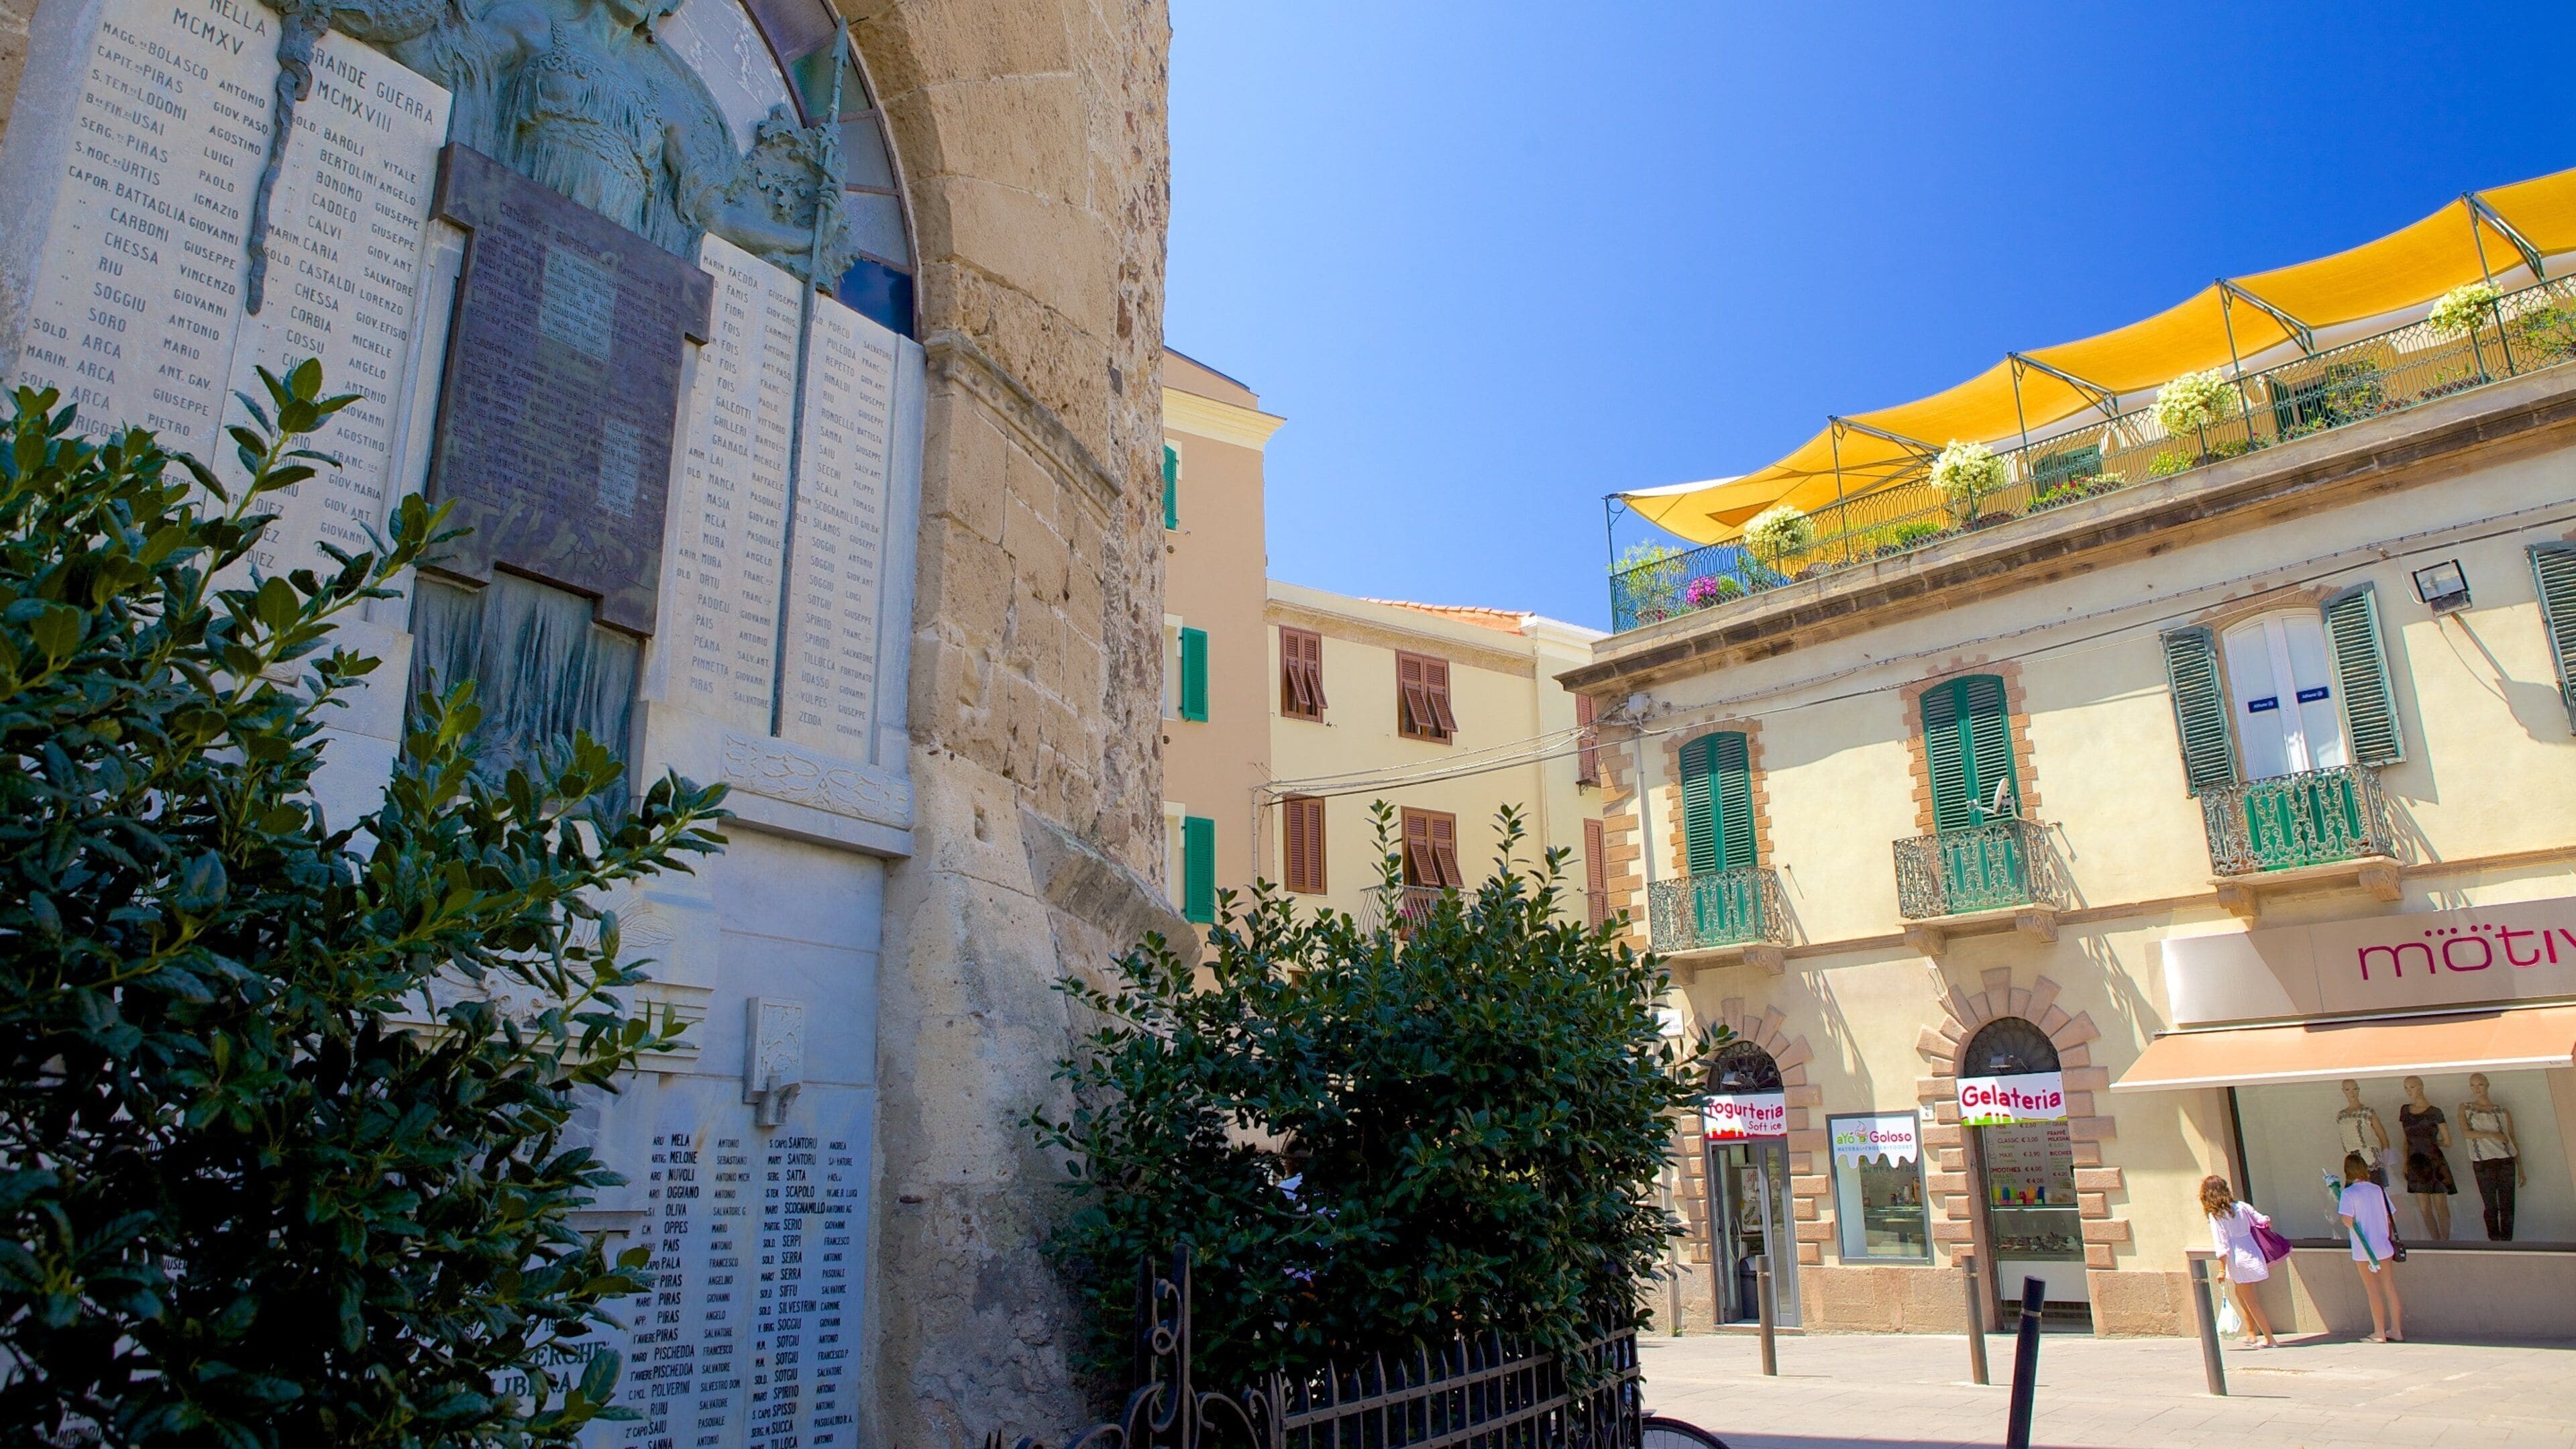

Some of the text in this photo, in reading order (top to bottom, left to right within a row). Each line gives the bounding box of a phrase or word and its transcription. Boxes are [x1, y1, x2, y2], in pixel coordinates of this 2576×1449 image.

[210, 0, 266, 36] NELLA
[173, 7, 244, 55] MCMXV
[148, 42, 266, 109] BOLASCO ANTONIO
[142, 64, 270, 136] PIRAS GIOV. PASQ.
[317, 80, 392, 133] MCMXVIII
[376, 82, 433, 125] GUERRA
[136, 87, 262, 155] LODONI AGOSTINO
[131, 111, 234, 168] USAI LUIGI
[126, 134, 234, 193] PIRAS PAOLO
[324, 127, 417, 184] BAROLI VITALE
[319, 148, 416, 207] BERTOLINI ANGELO
[121, 158, 239, 220] URTIS IGNAZIO
[69, 166, 239, 246] CAPOR. BATTAGLIA GIOVANNI
[316, 170, 419, 231] BONOMO GIUSEPPE
[308, 215, 342, 240] CALVI
[312, 193, 415, 252] CADDEO GIUSEPPE
[110, 207, 236, 270] CARBONI GIUSEPPE
[105, 231, 236, 295] CHESSA VINCENZO
[303, 237, 414, 297] CARIA SALVATORE
[99, 256, 227, 318] RIU GIOVANNI
[299, 260, 403, 316] CASTALDI LORENZO
[729, 267, 798, 310] FAEDDA GIUSEPPE
[93, 282, 220, 341] SOGGIU ANTONIO
[294, 283, 407, 341] CHESSA GIOV. EFISIO
[725, 303, 745, 320] FIORI
[87, 307, 200, 360] SORO MARIO
[291, 306, 392, 359] CORBIA MICHELE
[724, 321, 741, 337] FOIS
[33, 318, 212, 392] SOLD. ARCA ANT. GAV.
[286, 329, 386, 380] COSSU ANGELO
[26, 344, 210, 417] MARIN. ARCA GIUSEPPE
[345, 381, 387, 405] ANTONIO
[822, 390, 835, 403] RIU
[70, 386, 191, 437] ARCA PIETRO
[716, 396, 751, 420] GALEOTTI
[714, 415, 747, 437] GHILLERI
[337, 427, 385, 452] AGOSTINO
[712, 434, 781, 472] GRANADA MICHELE
[819, 444, 835, 460] SAIU
[710, 453, 784, 492] LAI RAFFAELE
[818, 462, 841, 480] SECCHI
[329, 474, 381, 500] GIOV. MARIA
[816, 481, 839, 498] SCALA
[751, 492, 782, 511] PASQUALE
[321, 522, 366, 545] GIOVANNI
[703, 532, 725, 550] MURA
[705, 513, 780, 550] MELA PASQUALE
[812, 537, 836, 554] SOGGIU
[247, 549, 275, 569] DIEZ
[702, 553, 722, 570] MURA
[700, 573, 720, 589] ORTU
[698, 594, 730, 613] PADDEU
[696, 614, 714, 629] PAIS
[1962, 1084, 2061, 1110] Gelateria
[1748, 1121, 1782, 1131] Soft ice
[1870, 1130, 1912, 1143] Goloso
[671, 1134, 690, 1146] MELA
[788, 1136, 818, 1149] SANTORU
[669, 1151, 698, 1164] MELONE
[788, 1153, 816, 1165] SANTORU
[786, 1169, 806, 1181] SATTA
[667, 1186, 699, 1199] OGGIANO
[786, 1185, 815, 1198] SCAPOLO
[666, 1203, 687, 1216] OLIVA
[664, 1221, 688, 1234] OPPES
[783, 1218, 802, 1230] SERIO
[663, 1238, 680, 1252] PAIS
[661, 1257, 681, 1270] PALA
[782, 1251, 802, 1264] SERRA
[659, 1274, 682, 1287] PIRAS
[780, 1267, 802, 1281] SERRA
[780, 1285, 798, 1297] SIFFU
[657, 1310, 726, 1324] PIRAS ANGELO
[778, 1300, 817, 1314] SILVESTRINI
[776, 1335, 800, 1348] SOTGIU
[654, 1344, 695, 1361] PISCHEDDA
[653, 1362, 693, 1379] PISCHEDDA
[651, 1380, 690, 1398] POLVERINI
[649, 1419, 667, 1436] SAIU
[771, 1419, 794, 1434] SUCCA
